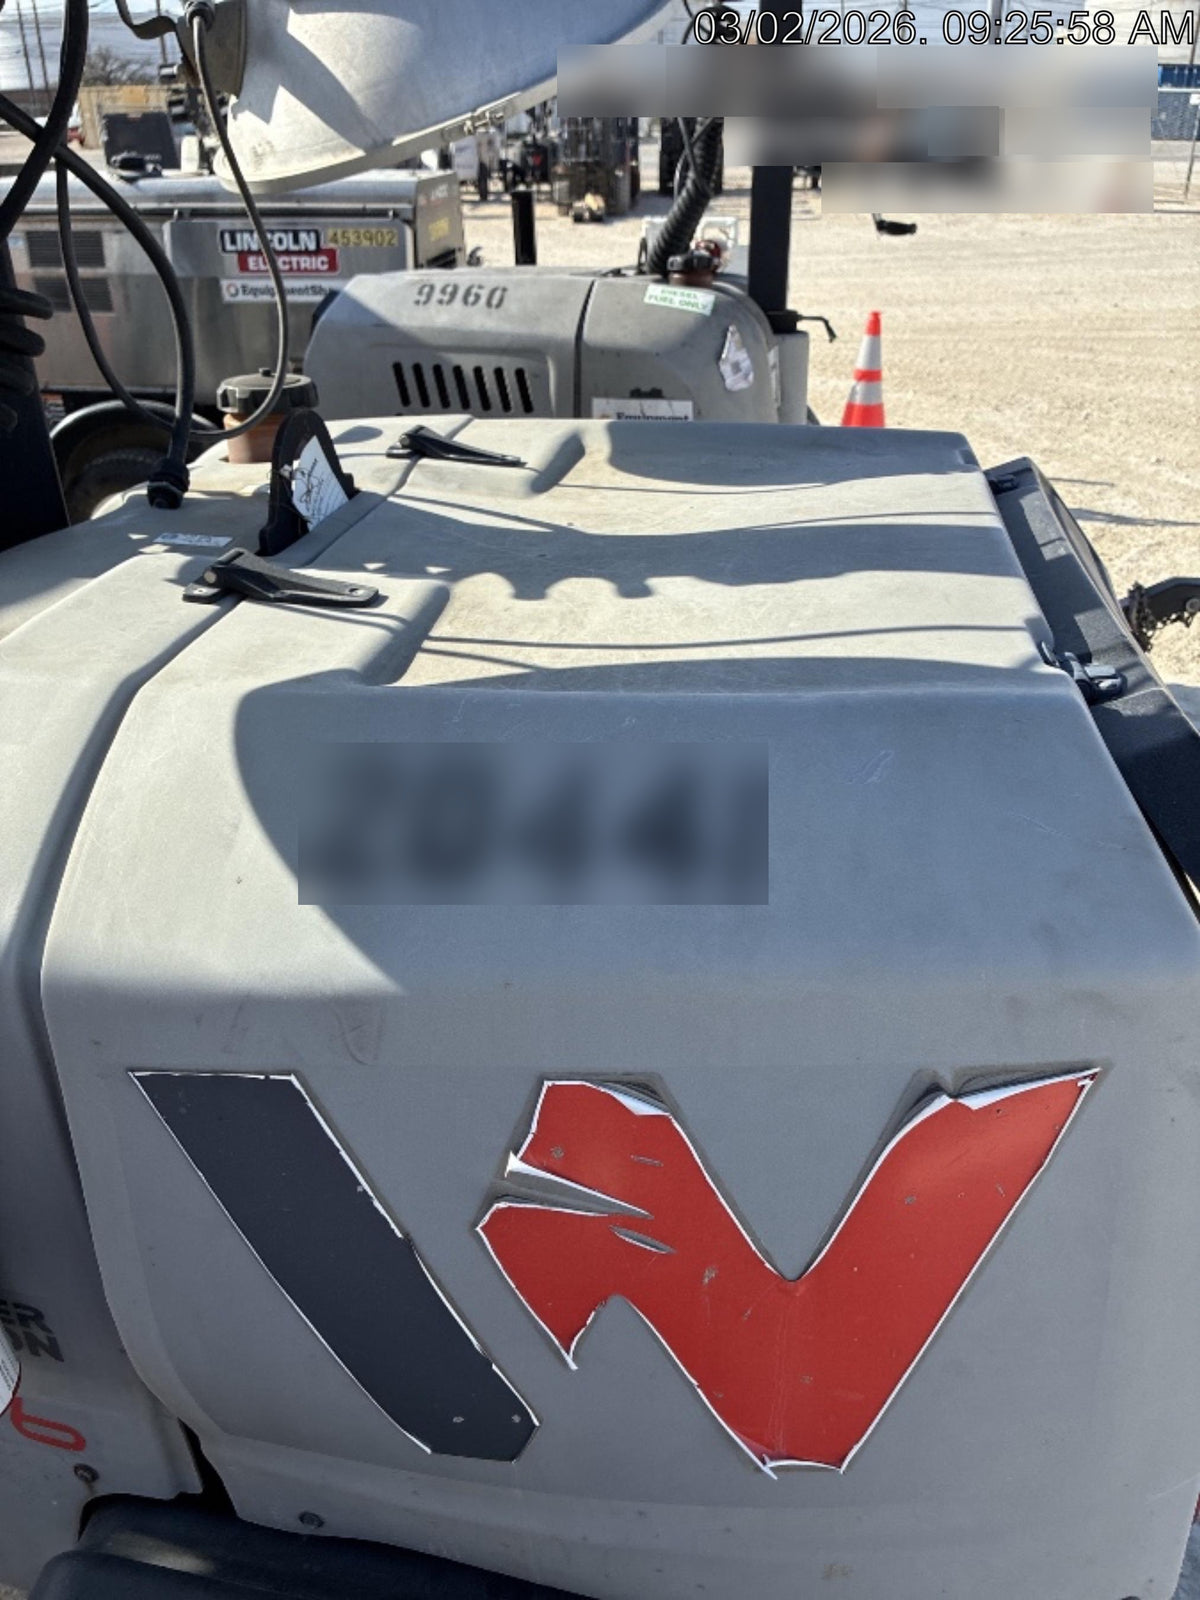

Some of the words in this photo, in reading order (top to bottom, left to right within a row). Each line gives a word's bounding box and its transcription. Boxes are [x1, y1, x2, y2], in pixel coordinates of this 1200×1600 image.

[223, 231, 318, 252] LINOLN
[328, 229, 396, 247] 453902
[246, 255, 329, 271] ELCTRIC
[413, 283, 508, 310] 9960
[648, 293, 675, 305] FUEL
[678, 298, 710, 312] ONLY
